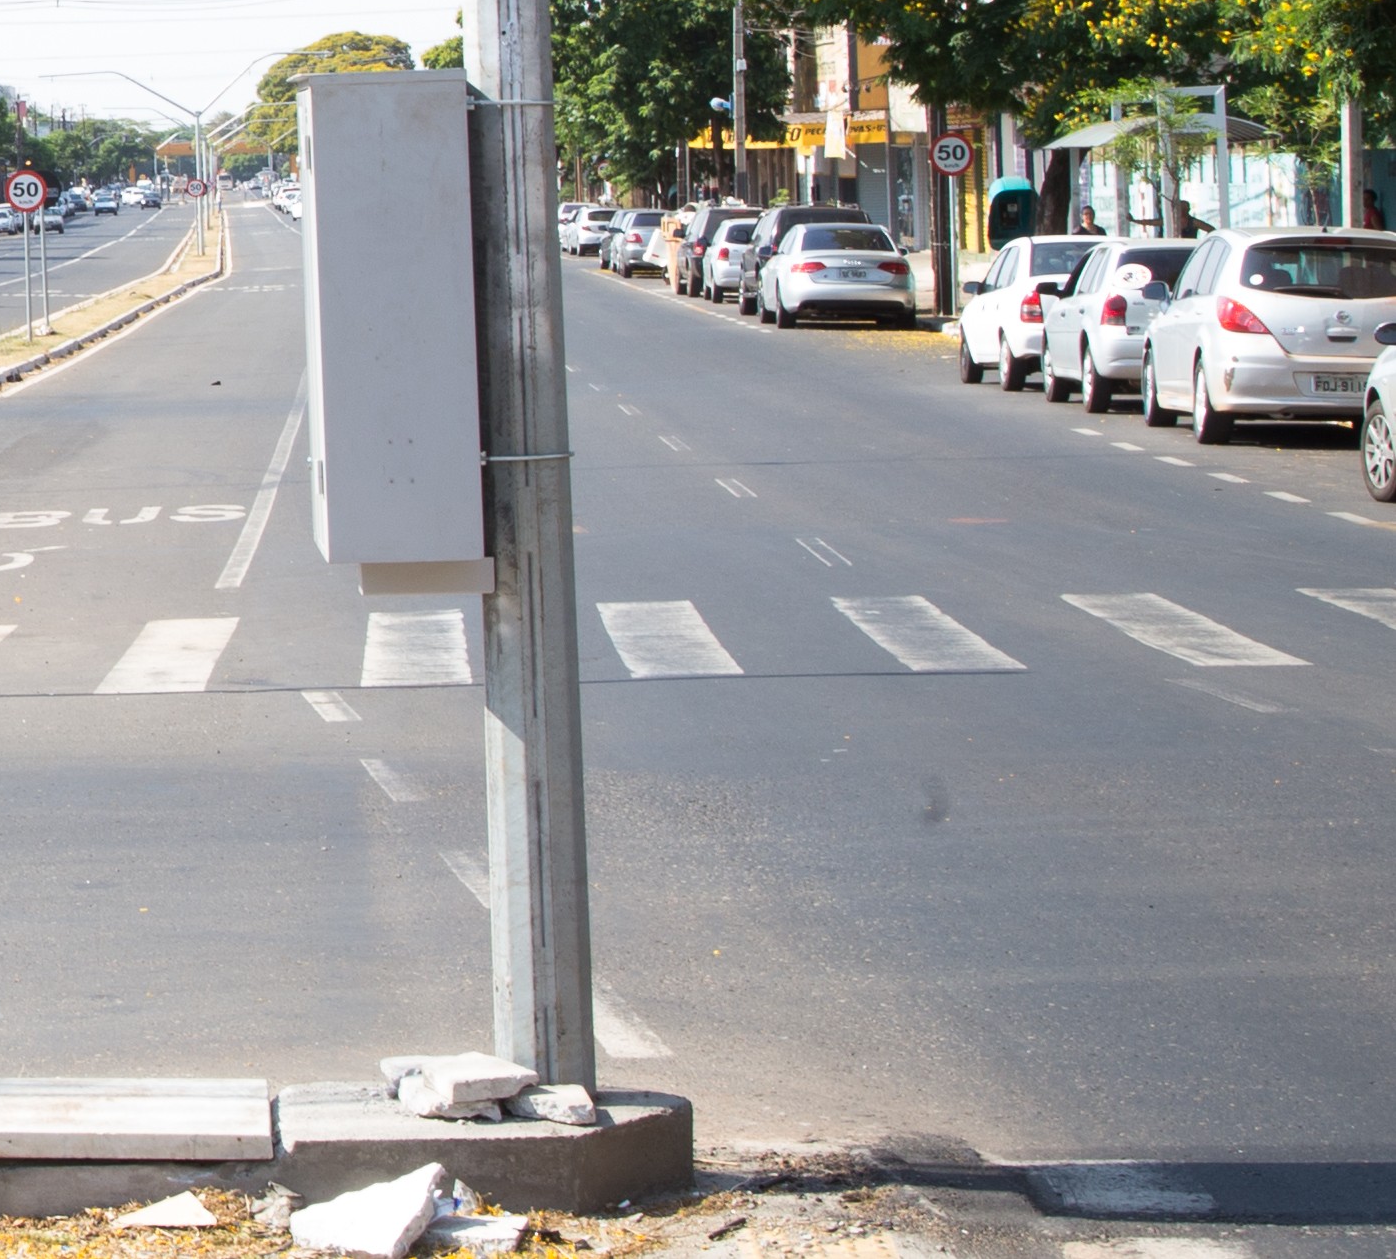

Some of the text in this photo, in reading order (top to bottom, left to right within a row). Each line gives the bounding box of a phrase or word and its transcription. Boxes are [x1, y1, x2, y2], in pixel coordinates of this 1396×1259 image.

[937, 144, 966, 161] 50
[13, 182, 39, 197] 50
[189, 184, 202, 192] 50
